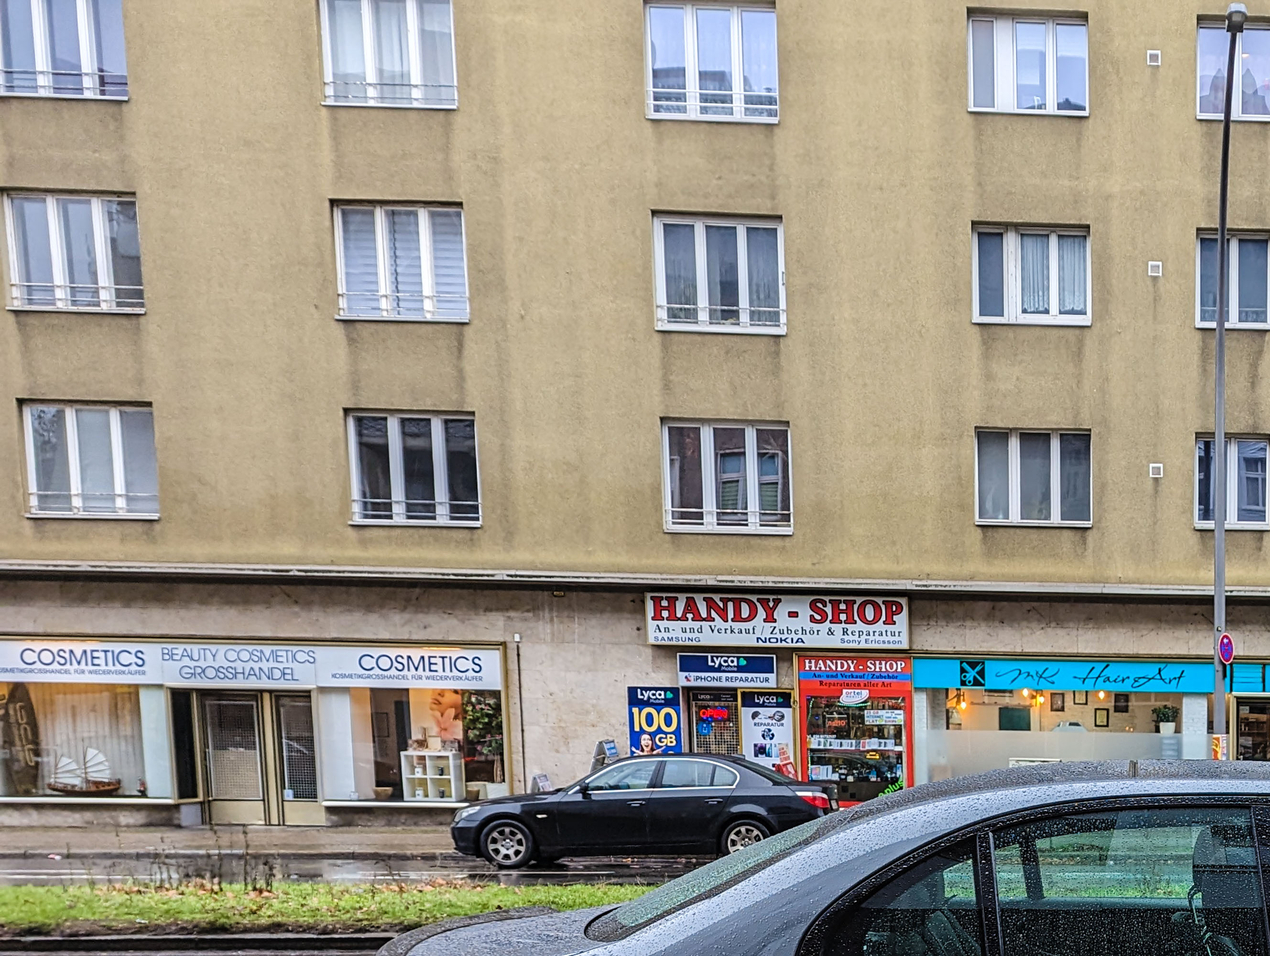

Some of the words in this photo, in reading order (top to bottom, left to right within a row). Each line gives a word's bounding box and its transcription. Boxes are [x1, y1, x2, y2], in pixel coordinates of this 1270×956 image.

[650, 595, 782, 624] HANDY
[808, 597, 904, 626] SHOP
[653, 624, 676, 634] An-
[681, 624, 704, 634] und
[708, 624, 757, 635] Verkauf
[769, 626, 822, 636] Zubehör
[826, 626, 836, 637] &
[841, 627, 903, 639] Reparatur
[653, 635, 701, 643] SAMSUNG
[756, 636, 806, 645] NOKIA
[839, 637, 862, 646] Sony
[20, 647, 146, 668] COSMETICS
[161, 646, 219, 662] BEAUTY
[223, 648, 317, 665] COSMETICS
[707, 655, 738, 668] Lyca
[358, 653, 483, 674] COSMETICS
[804, 659, 857, 671] HANDY
[866, 660, 906, 672] SHOP
[87, 668, 147, 676] WIEDERVERKÄUFER
[178, 664, 300, 682] GROSSHANDEL
[331, 672, 410, 681] KOSMETIKGROSSHANDEL
[410, 673, 423, 681] FÜR
[425, 674, 484, 682] WIEDERVERKÄUFER
[1073, 663, 1130, 688] Hair
[1130, 663, 1186, 689] Art
[693, 675, 723, 683] iPHONE
[724, 675, 770, 684] REPARATUR
[819, 680, 862, 688] Reparaturen
[637, 688, 665, 701] Lyca
[754, 694, 777, 704] Lyca
[631, 706, 678, 733] 100
[655, 733, 677, 746] GB
